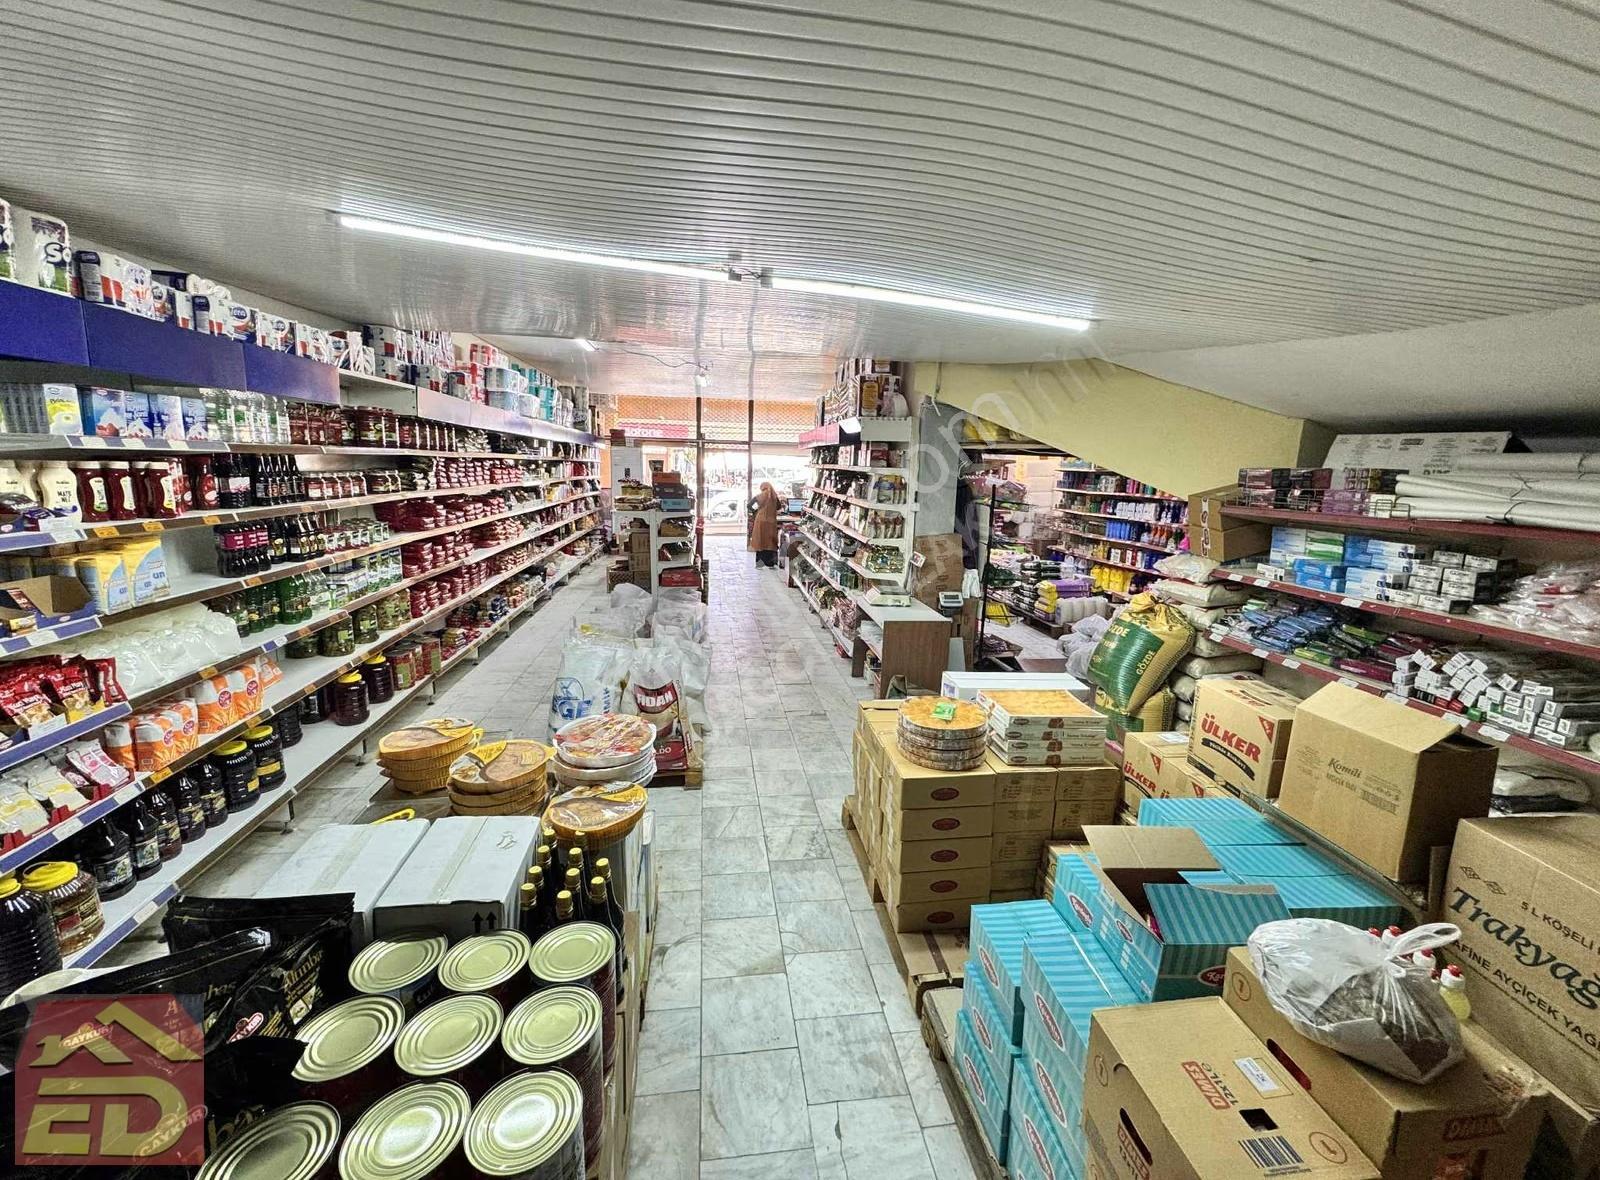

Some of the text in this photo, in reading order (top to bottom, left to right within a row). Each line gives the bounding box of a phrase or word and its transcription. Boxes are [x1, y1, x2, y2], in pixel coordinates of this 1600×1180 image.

[1135, 650, 1157, 676] GÖZDE
[1201, 713, 1261, 763] ÜLKER
[1123, 761, 1156, 793] ÜLKER
[1328, 758, 1362, 779] Komili
[1520, 901, 1594, 951] 5 L KÖŞELİ
[1453, 939, 1490, 971] AFİNE
[1492, 969, 1559, 1021] AYÇİÇEK
